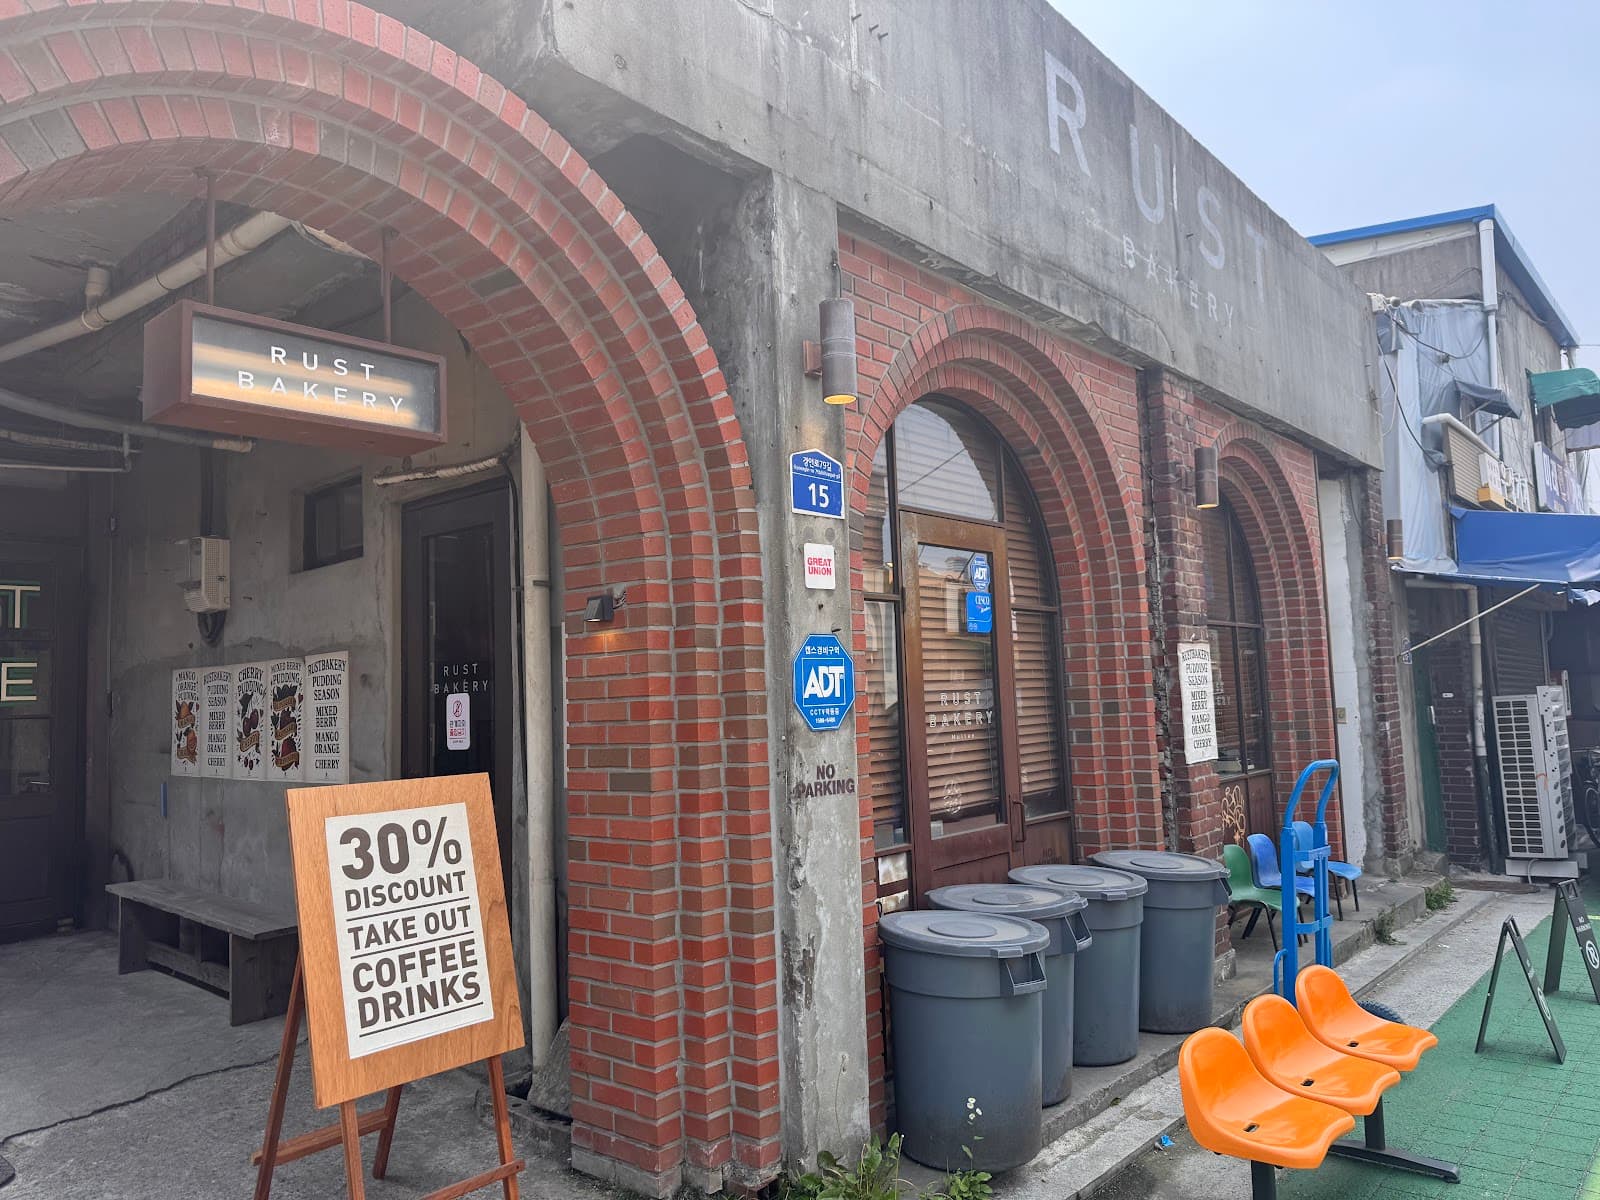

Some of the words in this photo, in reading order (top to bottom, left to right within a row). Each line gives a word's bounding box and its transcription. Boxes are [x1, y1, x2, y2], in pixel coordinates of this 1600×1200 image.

[1044, 49, 1266, 304] RUST
[1121, 233, 1235, 329] BAKERY
[270, 345, 375, 382] RUST
[237, 370, 404, 414] BAKERY
[808, 483, 830, 508] 15
[807, 557, 832, 567] GREAT
[808, 566, 832, 576] UNION
[0, 585, 41, 628] T
[308, 659, 347, 676] RUSTBAKERY
[443, 663, 478, 677] RUST
[1186, 663, 1208, 673] PUDDING
[238, 667, 263, 682] CHERRY
[273, 673, 300, 685] PUDDING
[312, 674, 342, 687] PUDDING
[1188, 675, 1208, 686] SEASON
[238, 681, 264, 696] PUDDING
[433, 680, 489, 694] BAKERY
[803, 665, 845, 699] ADT
[314, 688, 340, 701] SEASON
[940, 691, 981, 706] RUST
[208, 696, 226, 707] SEASON
[1192, 701, 1208, 711] BERRY
[208, 711, 226, 720] MIXED
[316, 705, 338, 717] MIXED
[208, 721, 226, 730] BERRY
[316, 717, 338, 728] BERRY
[929, 711, 993, 728] BAKERY
[1192, 713, 1210, 725] MANGO
[315, 731, 339, 742] MANGO
[1192, 725, 1211, 736] ORANGE
[207, 733, 227, 743] MANGO
[1193, 738, 1212, 749] CHERRY
[207, 743, 227, 753] ORANGE
[315, 743, 340, 754] ORANGE
[207, 757, 226, 767] CHERRY
[315, 759, 340, 770] CHERRY
[816, 763, 836, 780] NO
[796, 778, 855, 799] PARKING
[339, 816, 462, 880] 30%
[344, 870, 466, 912] DISCOUNT
[347, 915, 418, 951] TAKE
[424, 905, 471, 935] OUT
[352, 938, 478, 993] COFFEE
[357, 971, 481, 1029] DRINKS
